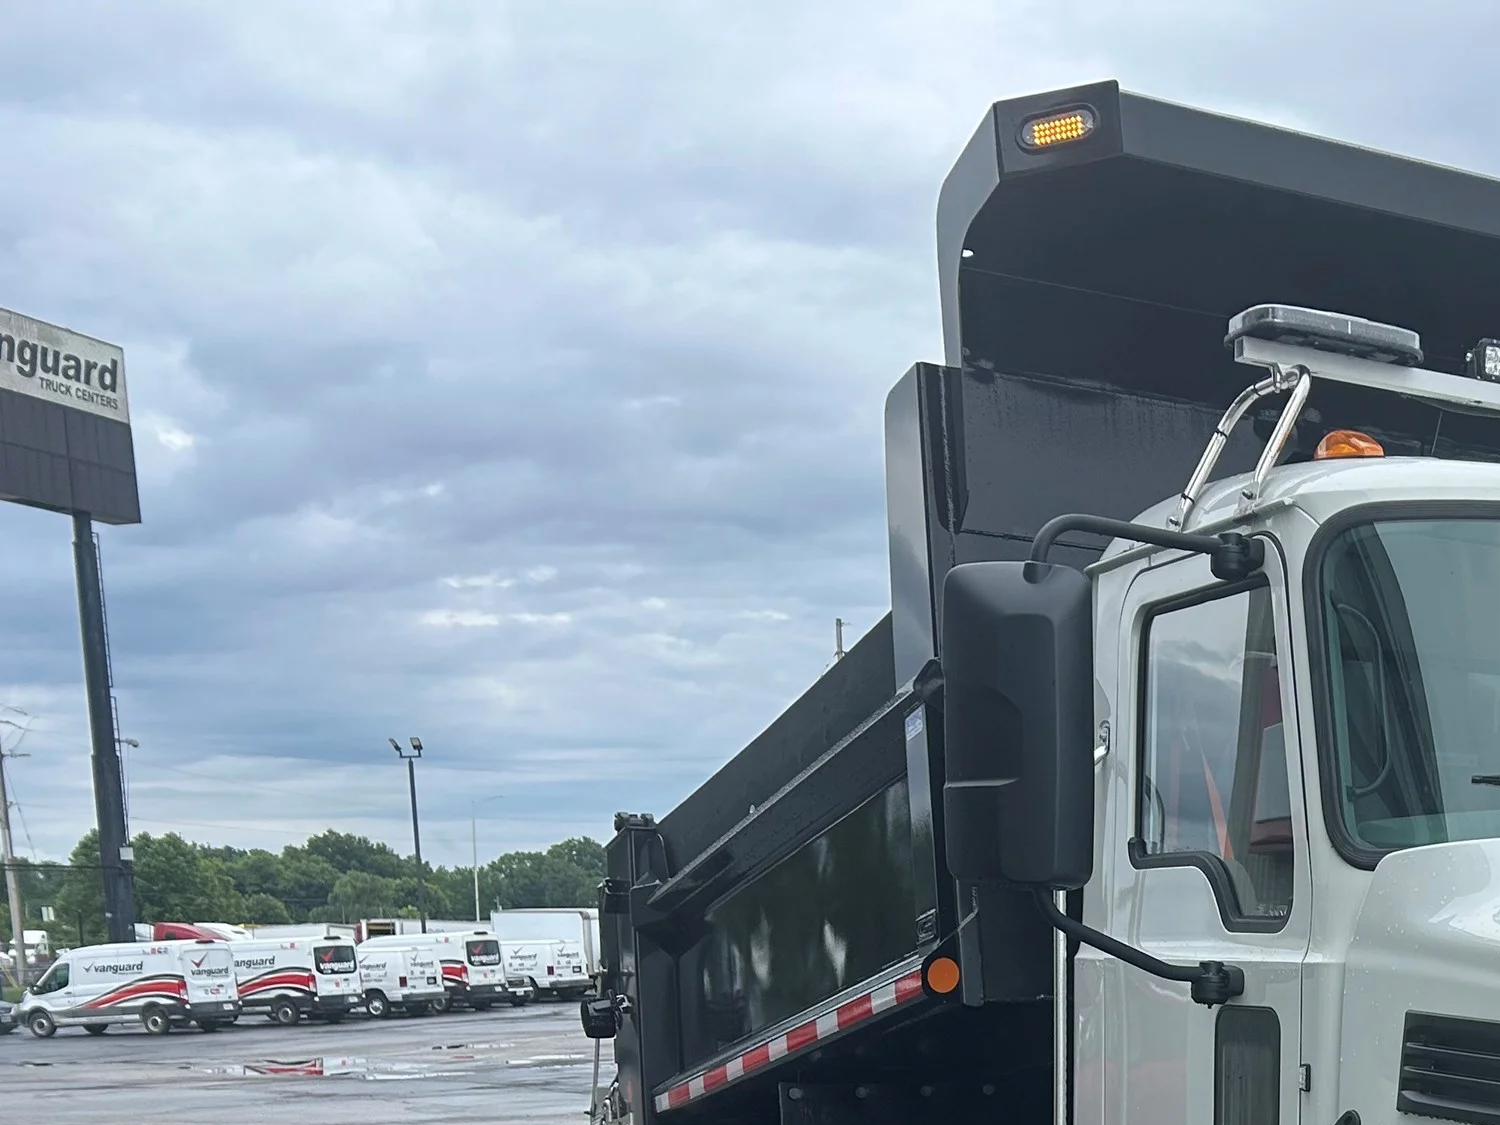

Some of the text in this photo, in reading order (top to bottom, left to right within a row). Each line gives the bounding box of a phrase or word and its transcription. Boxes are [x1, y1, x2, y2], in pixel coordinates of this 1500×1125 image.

[39, 377, 118, 410] TRUCK CENTERS
[94, 961, 143, 974] vanguard
[234, 956, 275, 968] anguard
[191, 966, 229, 977] vanguard
